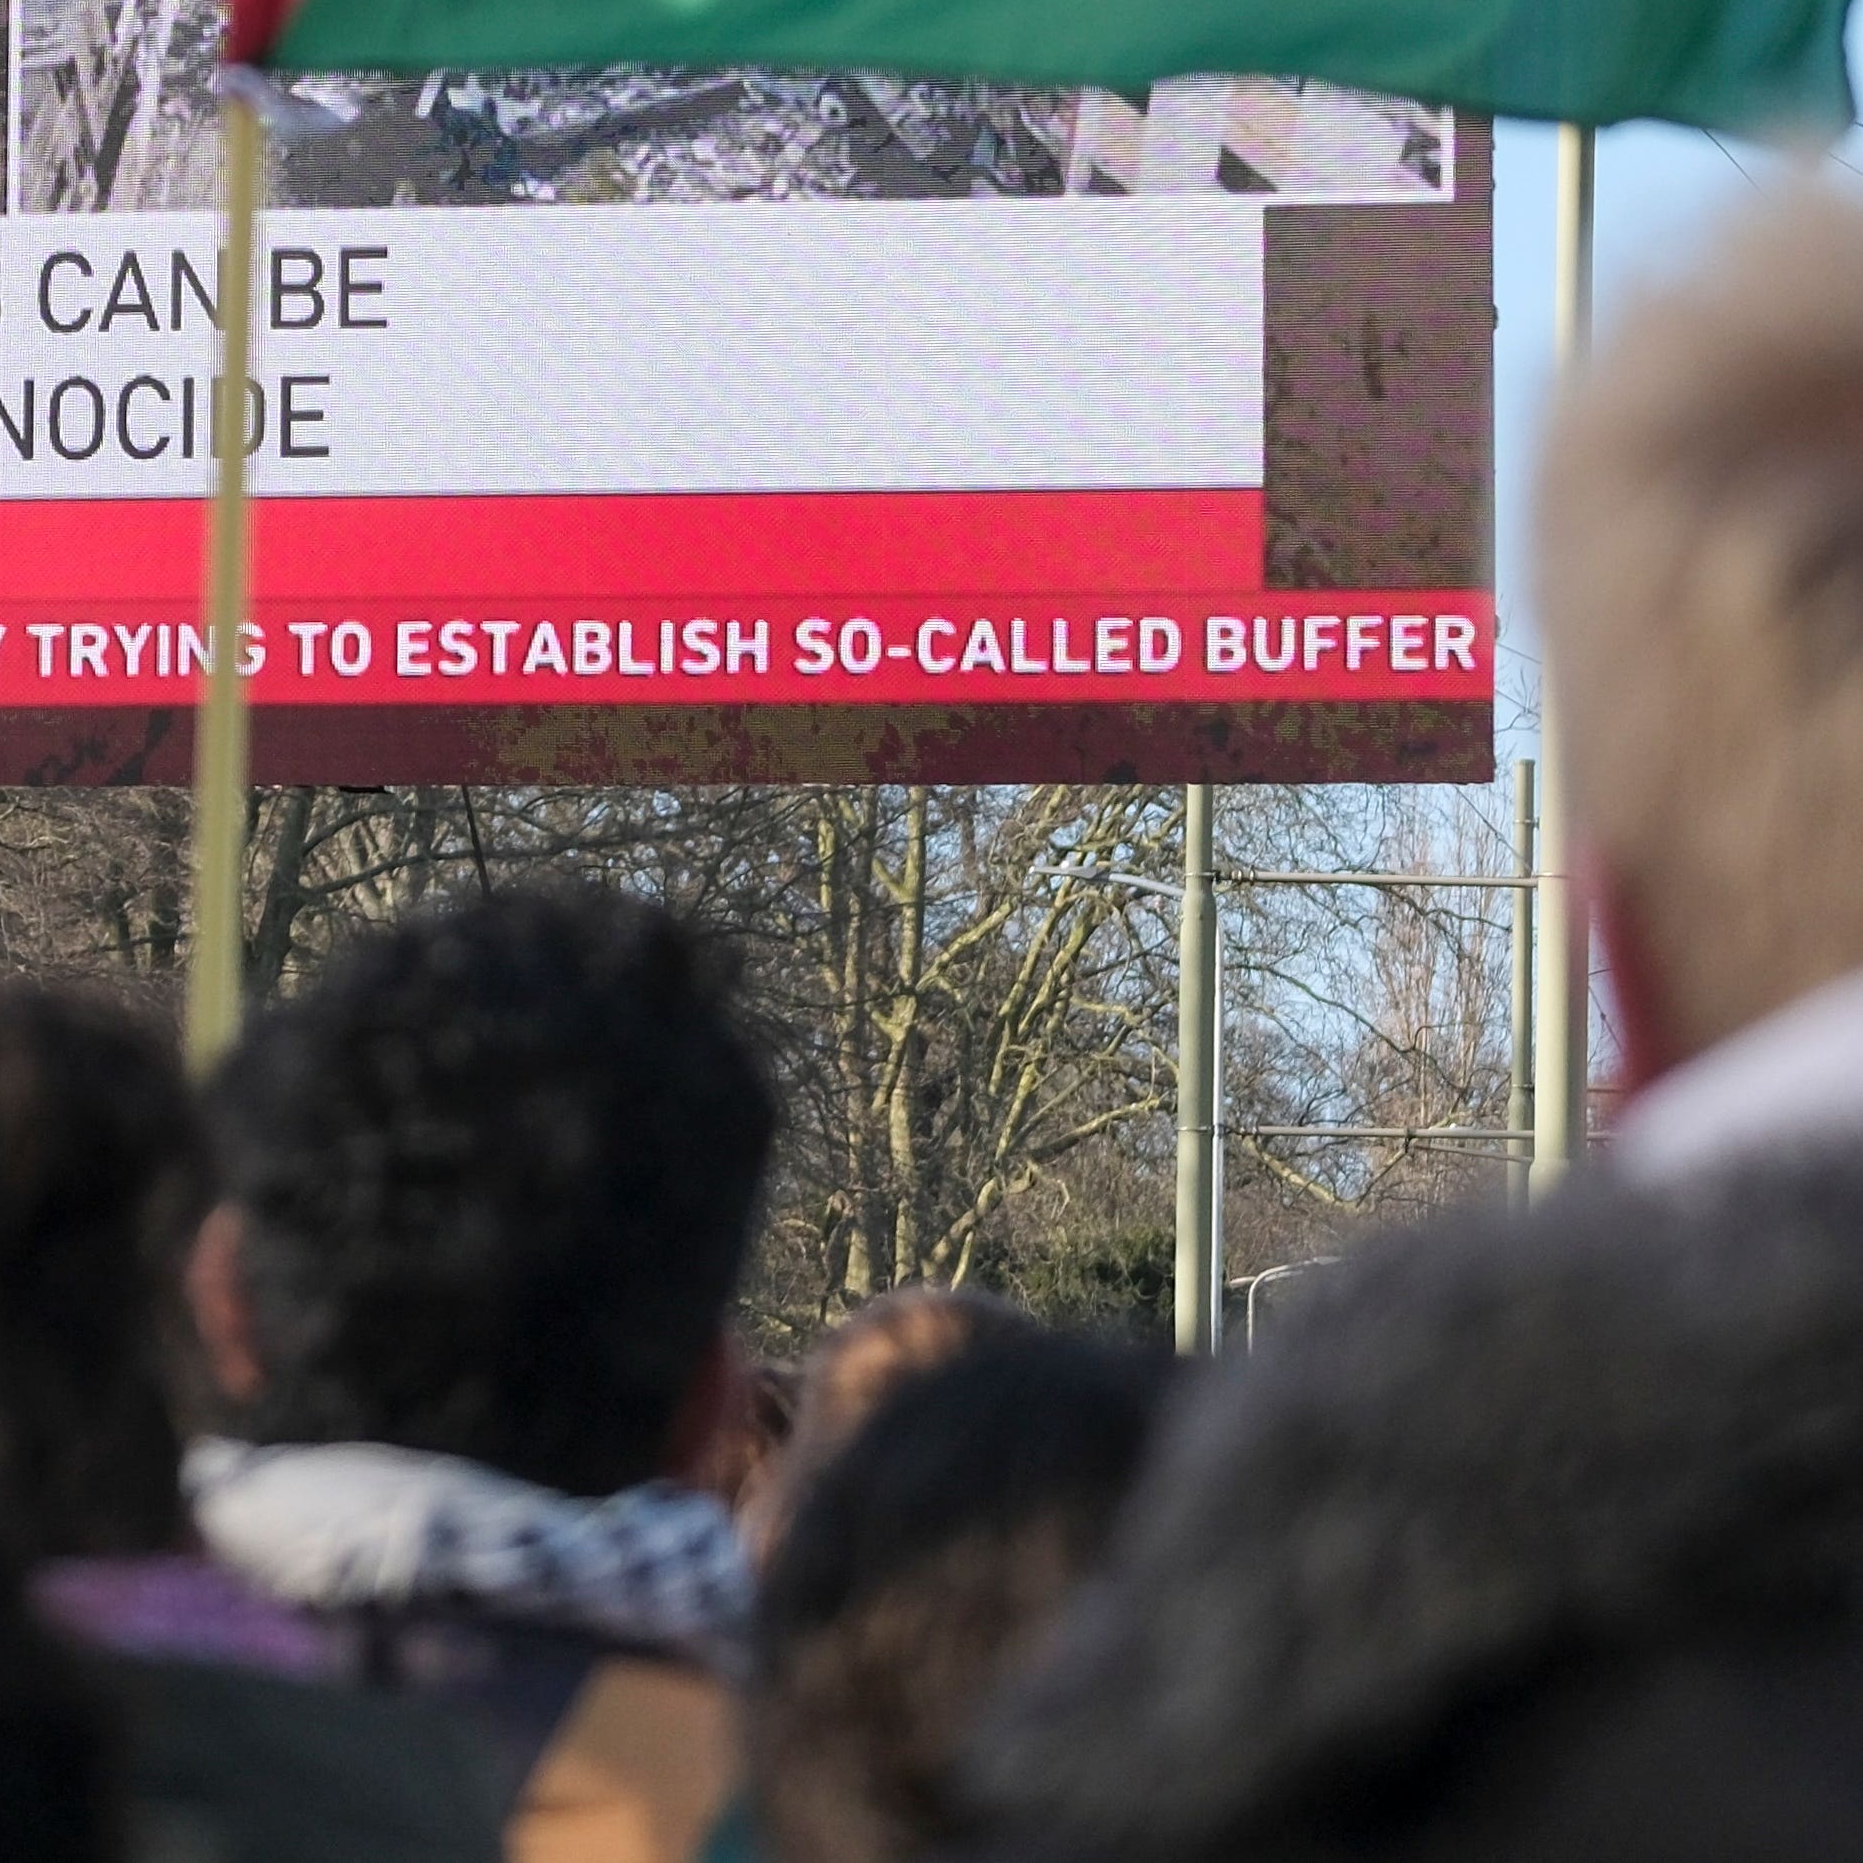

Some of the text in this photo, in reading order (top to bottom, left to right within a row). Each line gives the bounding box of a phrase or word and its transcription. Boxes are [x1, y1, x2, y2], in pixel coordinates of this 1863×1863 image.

[37, 248, 227, 333] CAN
[270, 246, 389, 329] BE
[26, 622, 265, 679] TRYING
[288, 620, 372, 676] TO
[396, 618, 769, 676] ESTABLISH
[794, 616, 1182, 674] SO-CALLED
[1206, 614, 1477, 672] BUFFER
